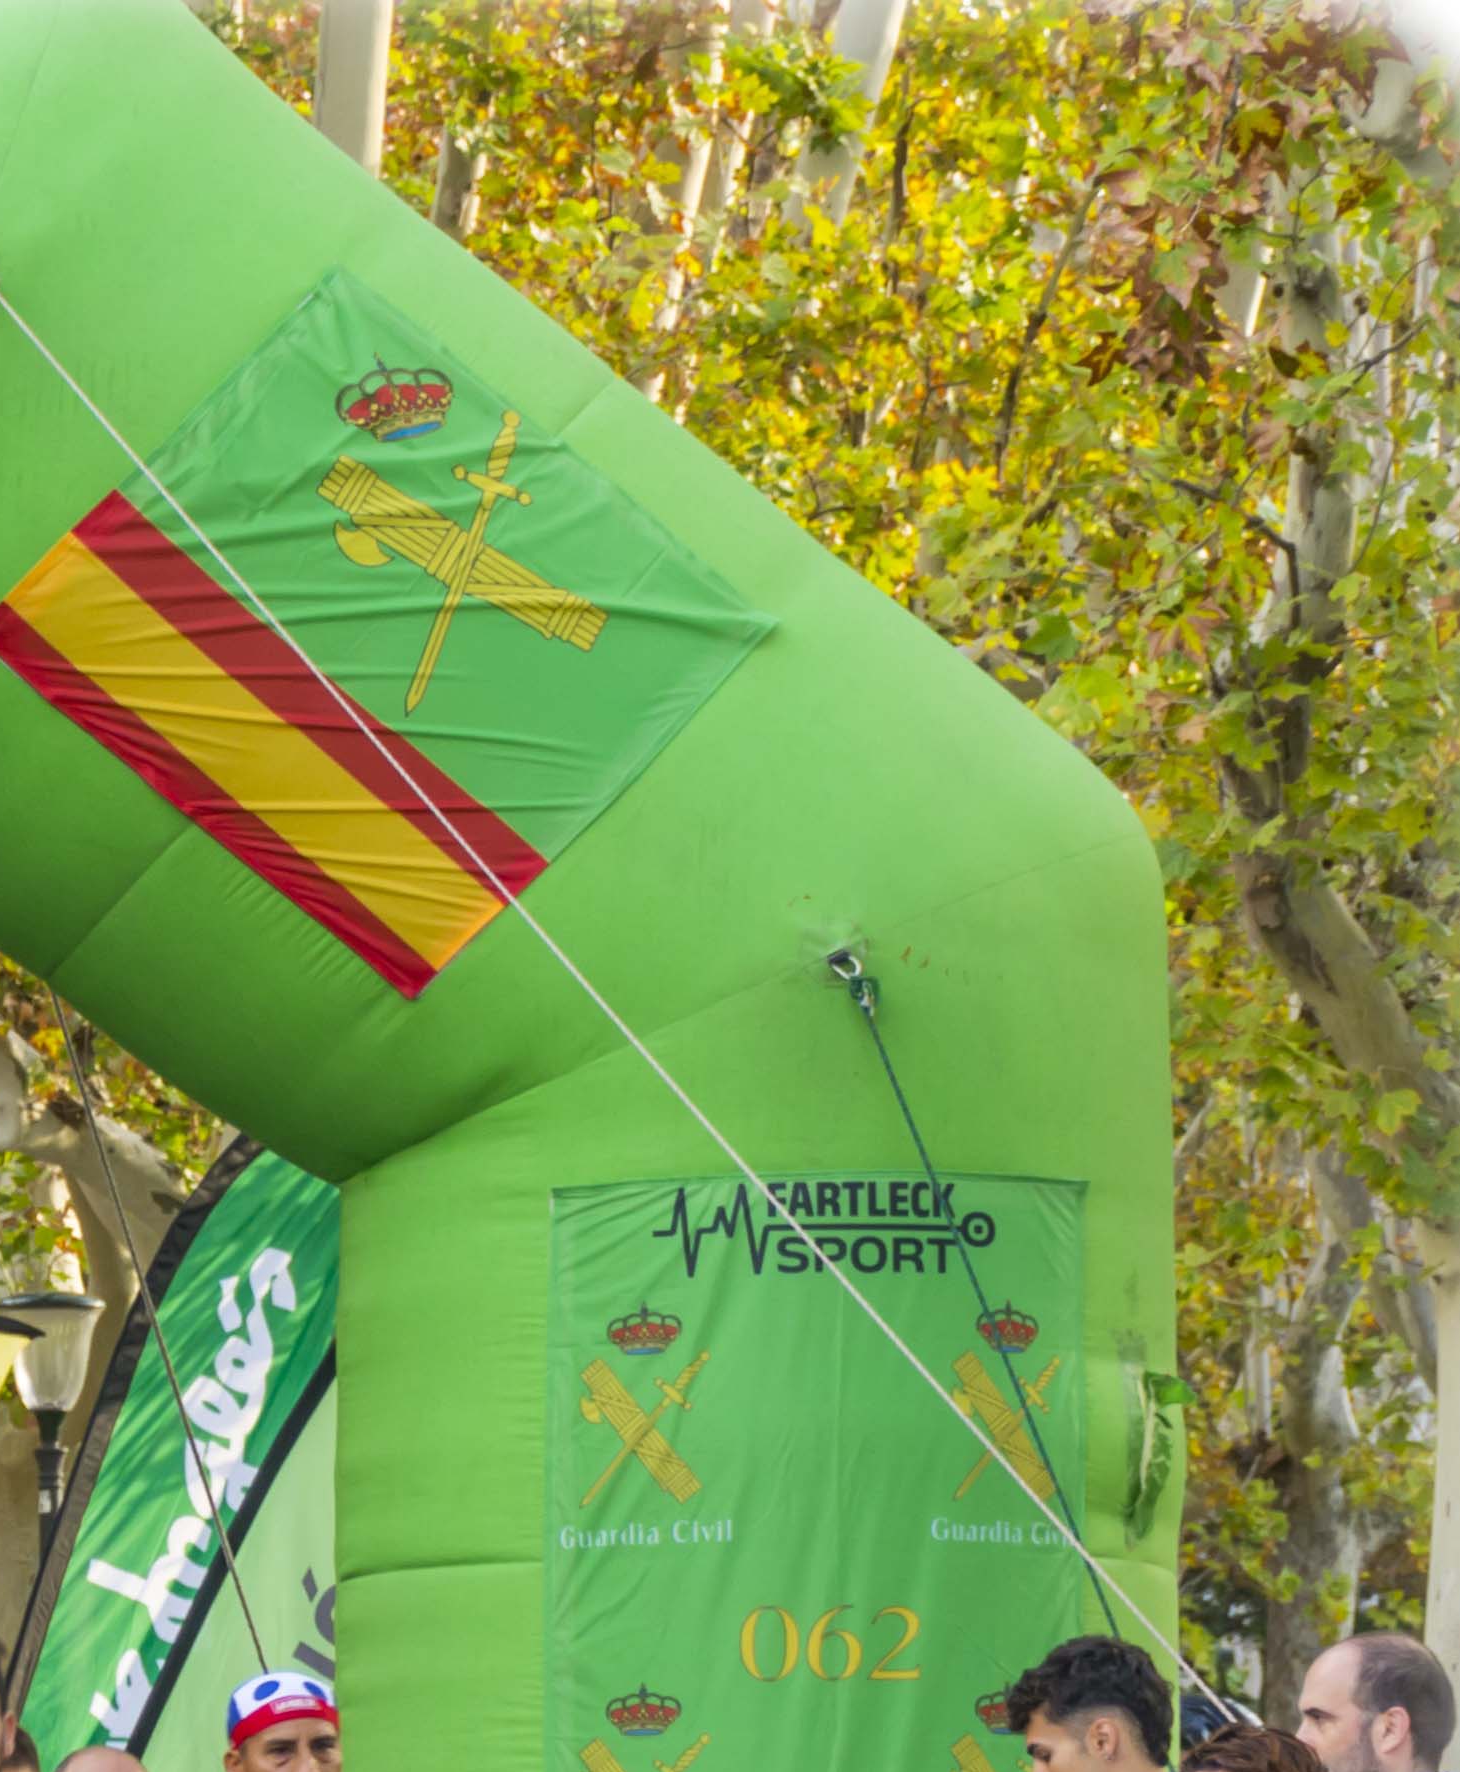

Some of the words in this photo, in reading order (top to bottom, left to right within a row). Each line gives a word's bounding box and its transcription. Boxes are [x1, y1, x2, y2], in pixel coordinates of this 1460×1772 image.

[766, 1180, 957, 1219] FARTLECK
[775, 1236, 959, 1274] SPORT
[559, 1519, 661, 1550] Guardia
[671, 1518, 735, 1545] Civil
[929, 1516, 1024, 1547] Guardia
[738, 1604, 921, 1682] 062
